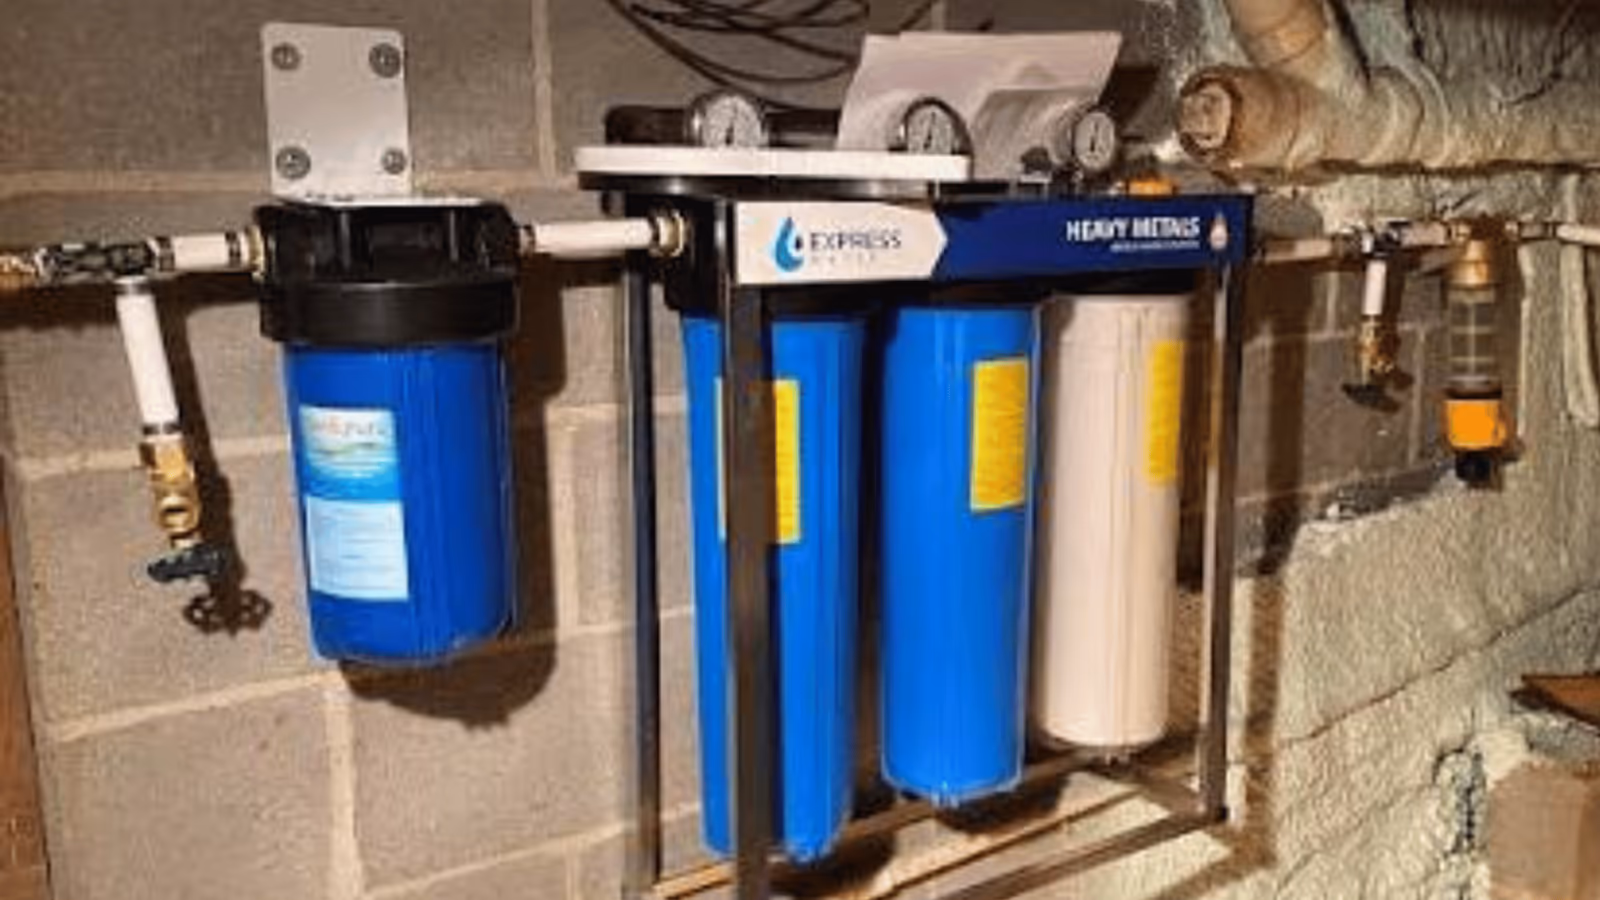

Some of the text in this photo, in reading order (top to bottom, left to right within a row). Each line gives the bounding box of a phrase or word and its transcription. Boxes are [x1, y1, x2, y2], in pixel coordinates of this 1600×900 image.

[810, 228, 902, 251] EXPRESS
[1066, 215, 1200, 242] HEAVY METALS
